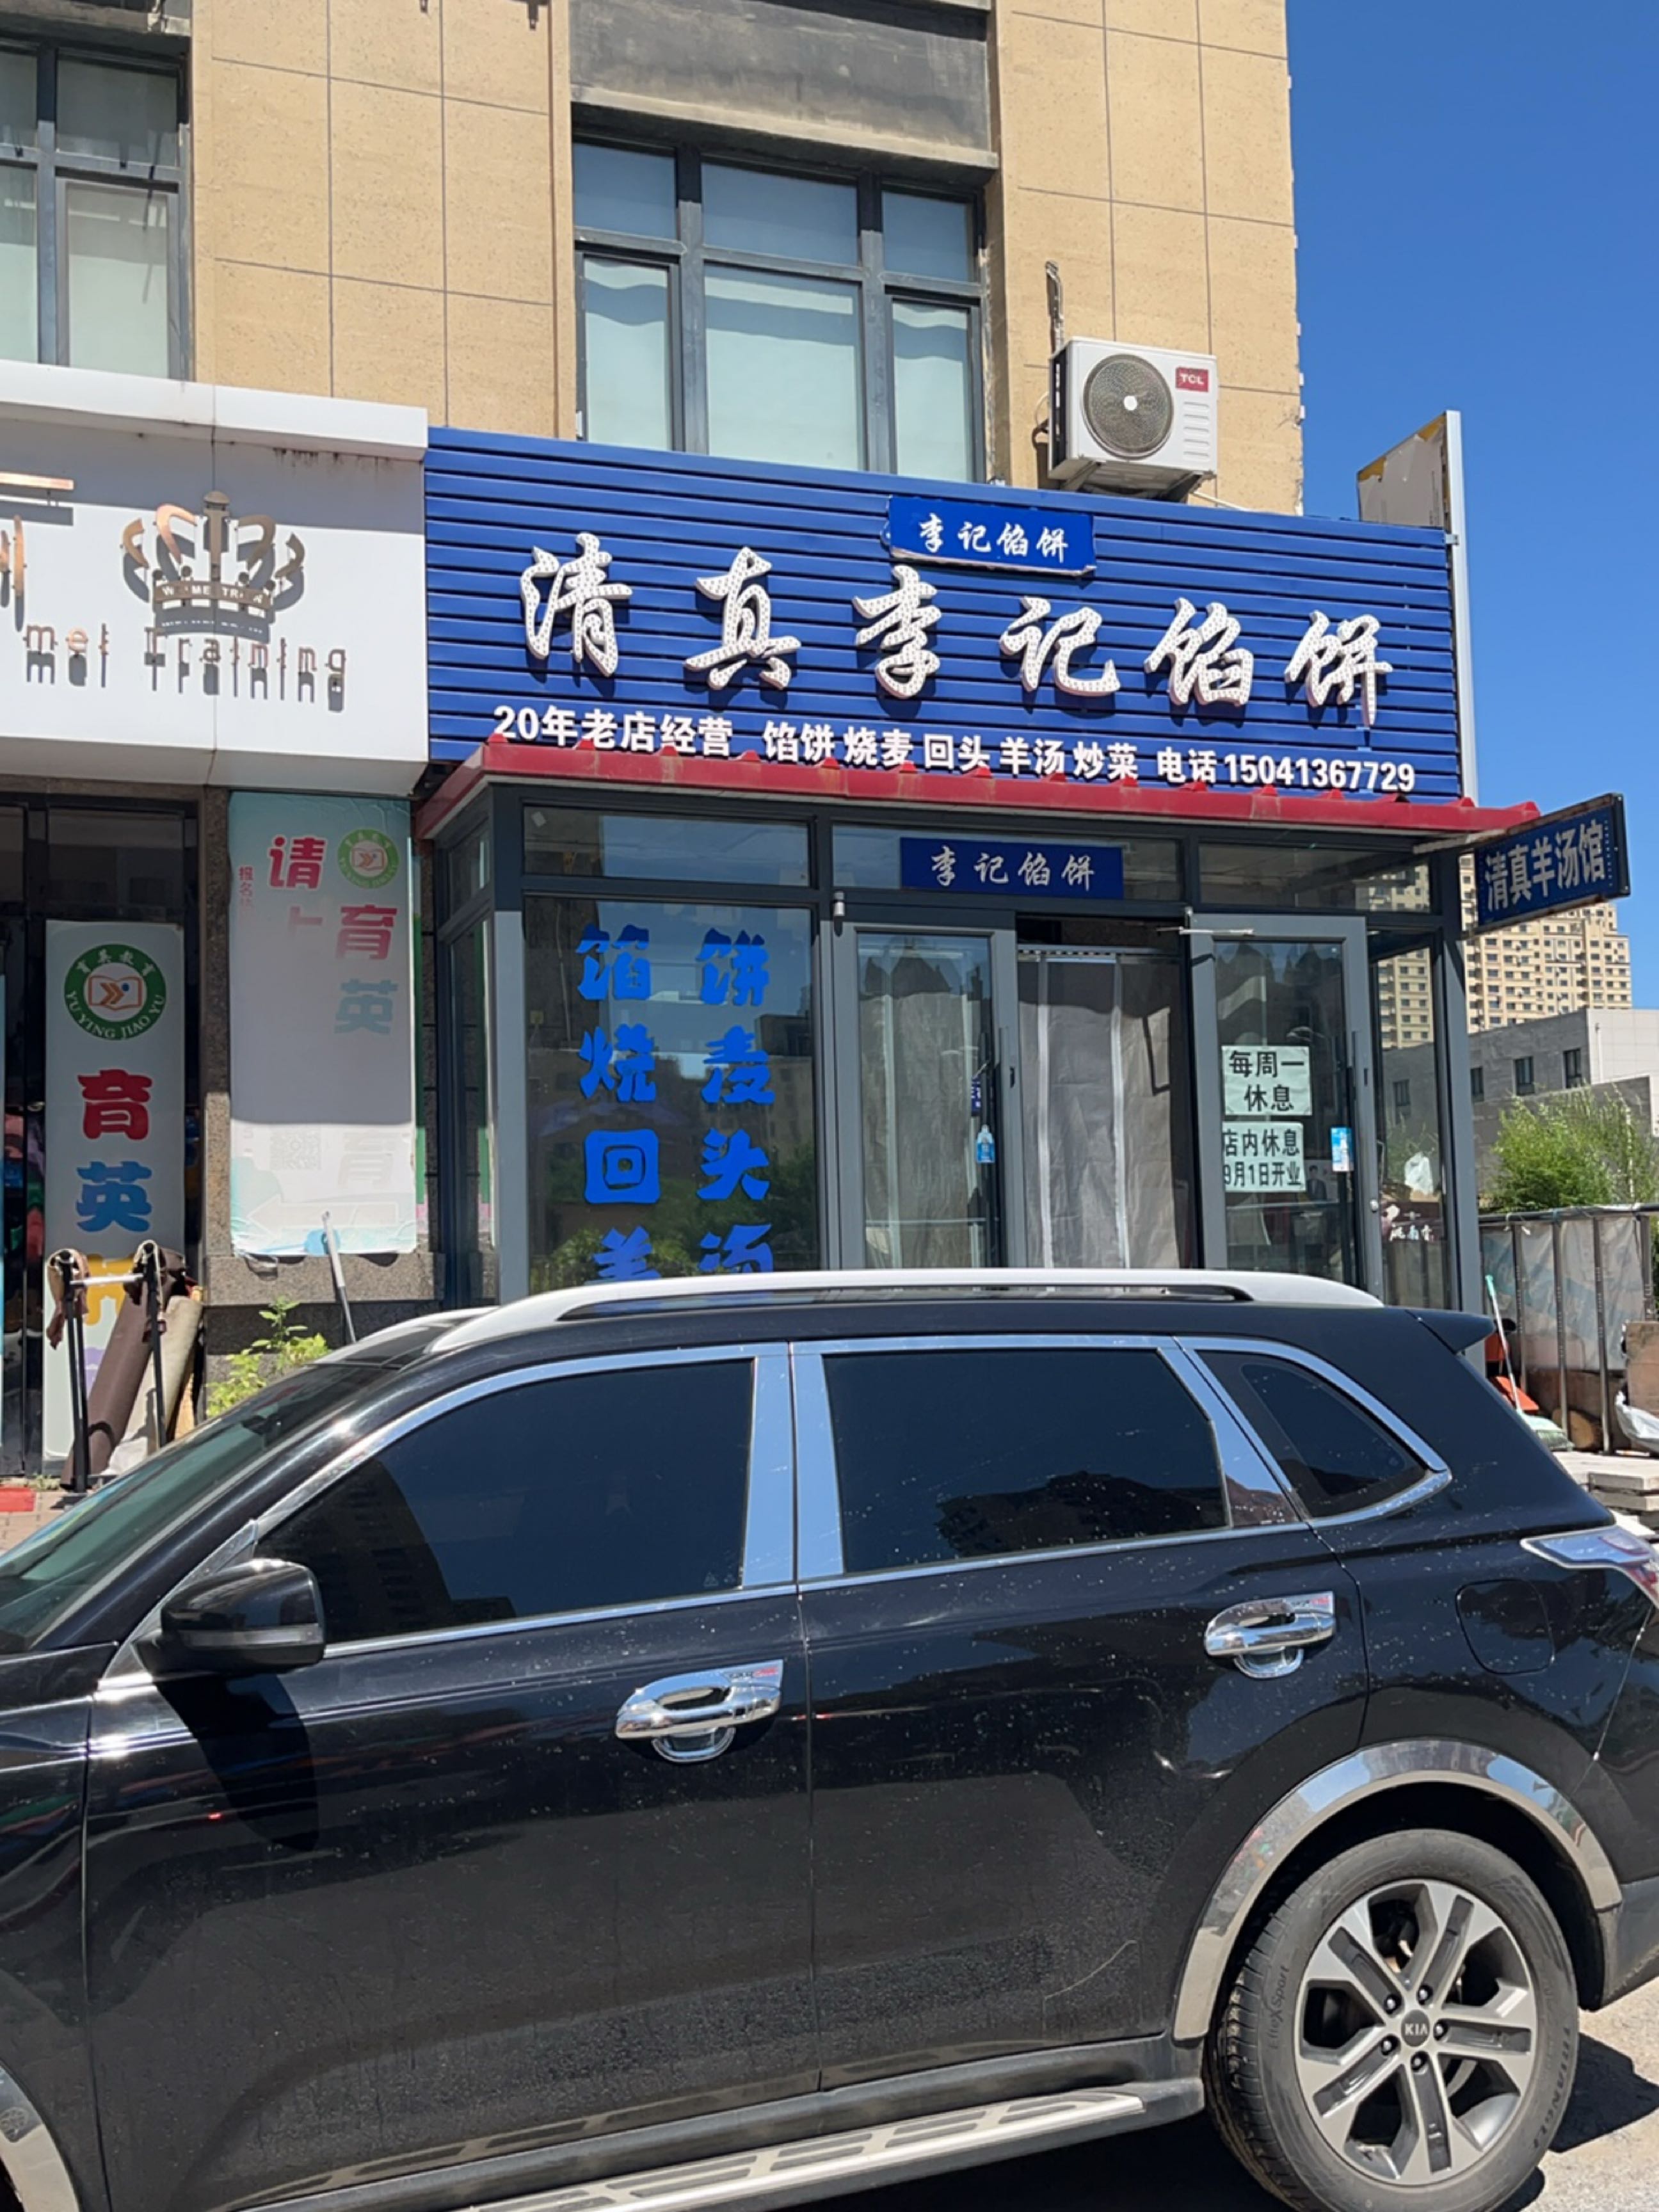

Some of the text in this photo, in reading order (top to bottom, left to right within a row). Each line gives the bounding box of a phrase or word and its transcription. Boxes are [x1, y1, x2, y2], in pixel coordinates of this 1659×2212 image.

[1179, 373, 1204, 384] TCL
[919, 513, 1068, 563] 李记馅饼
[520, 532, 1393, 727] 清真李记馅饼
[493, 705, 733, 757] 20年老店经营
[931, 845, 1095, 892] 李记馅饼
[1485, 819, 1606, 913] 清真羊汤馆
[1229, 1050, 1305, 1078] 每周一
[1244, 1084, 1294, 1112] 休息
[1222, 1128, 1300, 1157] 店内休息
[1224, 1161, 1302, 1187] 9月1日开业
[1405, 2023, 1428, 2035] KIA
